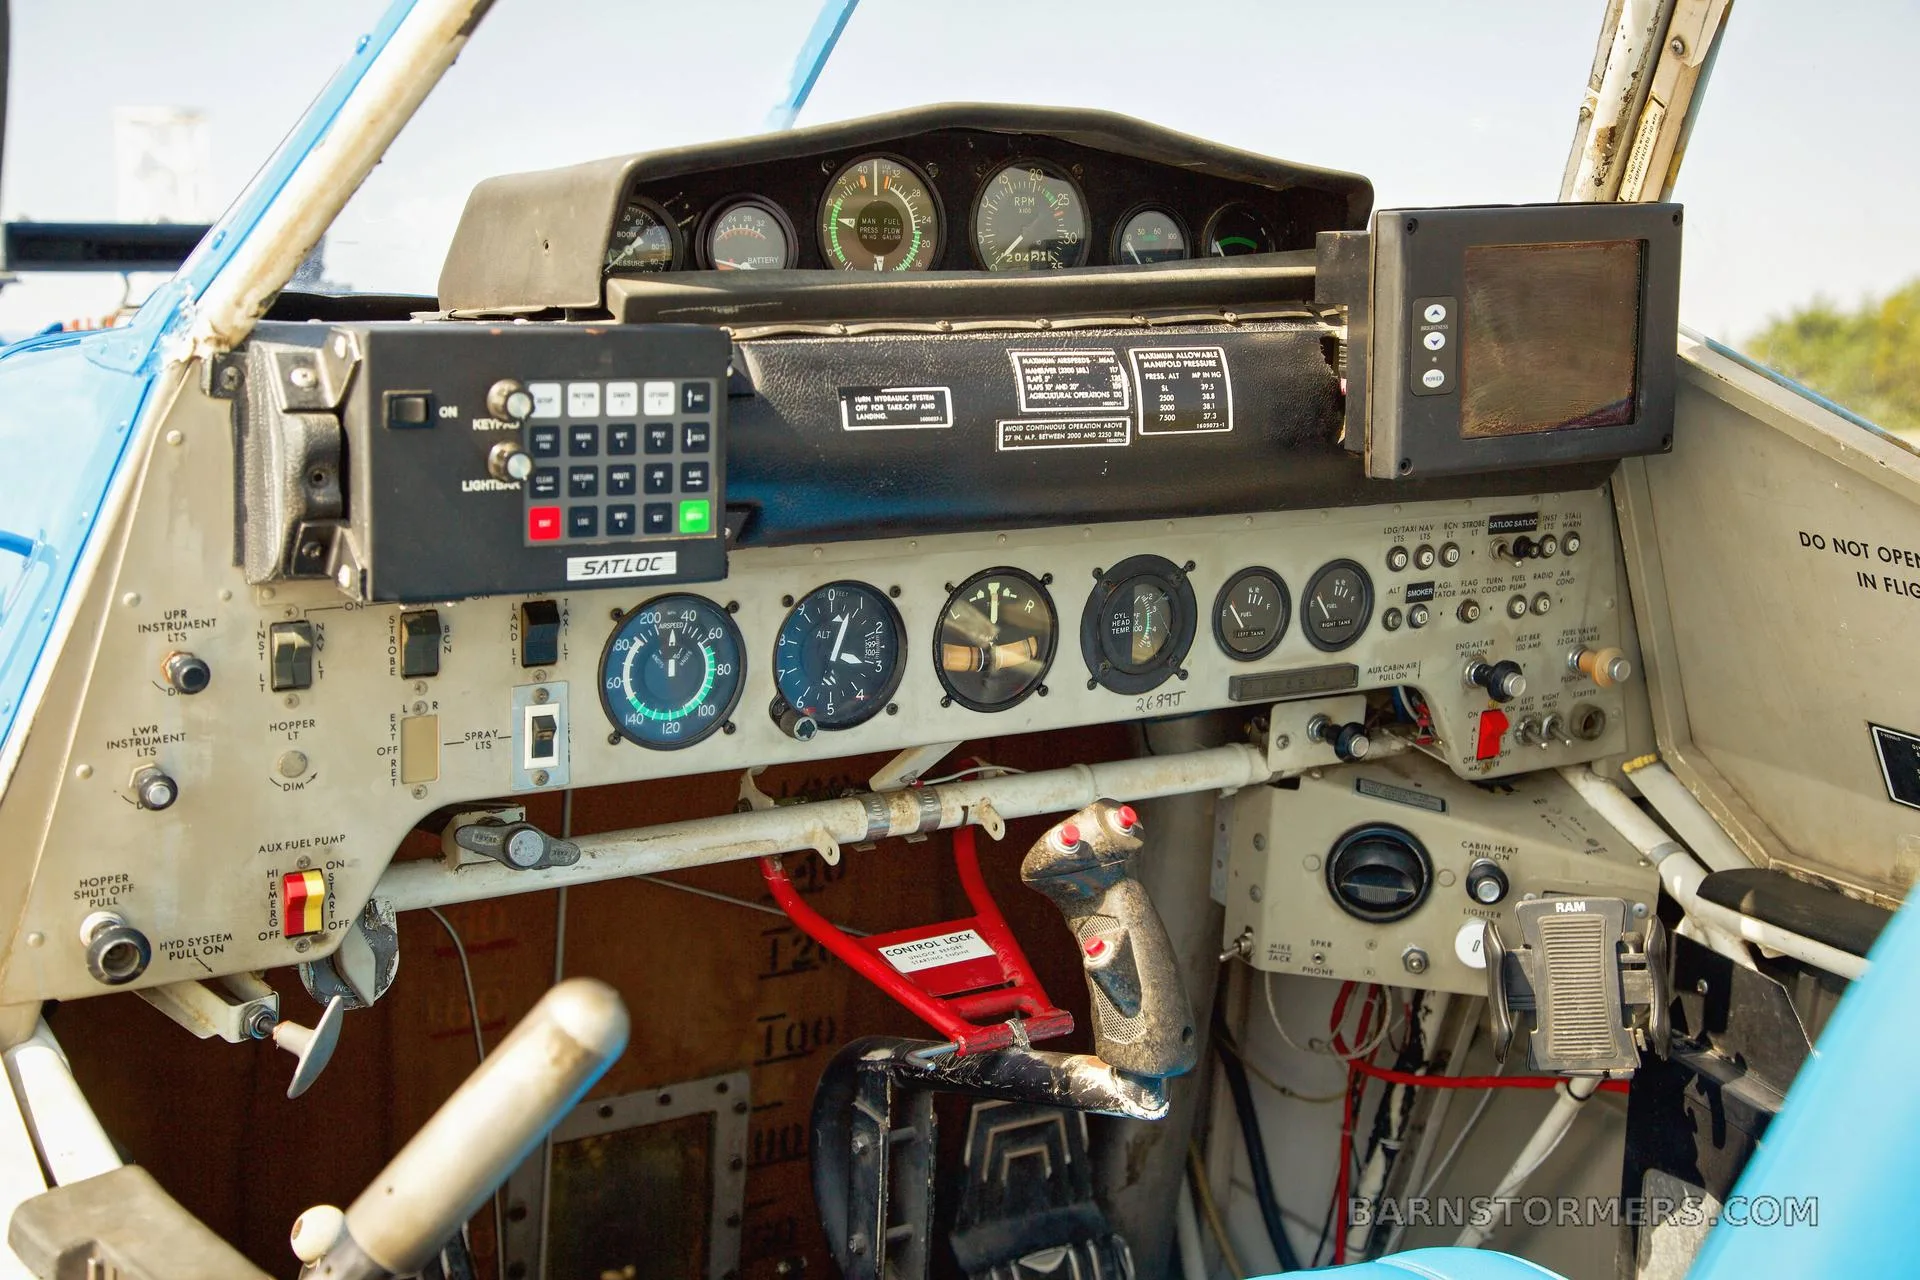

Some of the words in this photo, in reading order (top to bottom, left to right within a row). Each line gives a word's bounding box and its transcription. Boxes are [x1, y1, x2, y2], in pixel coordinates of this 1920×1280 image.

[1015, 197, 1034, 206] RPM
[1058, 194, 1069, 206] 25
[439, 407, 457, 418] ON
[1419, 524, 1434, 532] NAV
[1514, 519, 1537, 527] SATLOC
[1799, 531, 1825, 549] DO
[1833, 537, 1868, 559] NOT
[582, 557, 662, 575] SATLOC
[1461, 579, 1478, 587] FLAG
[1556, 578, 1574, 586] COND
[1857, 572, 1877, 590] IN
[1408, 588, 1433, 597] SMOKER
[1481, 585, 1506, 593] COORD
[165, 610, 187, 619] UPR
[640, 612, 661, 624] 200
[681, 611, 696, 621] 40
[138, 618, 216, 633] INSTRUMENT
[1112, 627, 1130, 635] TEMP.
[168, 632, 186, 642] LTS
[316, 624, 324, 652] NAV
[709, 628, 722, 639] 60
[257, 621, 265, 660] INST
[388, 616, 396, 676] STROBE
[318, 661, 324, 679] LT
[717, 664, 731, 675] 80
[1367, 666, 1382, 675] AUX
[1383, 664, 1406, 673] CABIN
[1407, 662, 1417, 670] AIR
[1379, 672, 1394, 680] PULL
[260, 674, 264, 692] LT
[698, 705, 715, 716] 100
[625, 714, 644, 725] 140
[133, 725, 158, 736] LWR
[270, 719, 315, 732] HOPPER
[662, 722, 680, 734] 120
[288, 732, 299, 741] LT
[465, 729, 498, 741] SPRAY
[107, 733, 186, 749] INSTRUMENT
[475, 741, 492, 749] LTS
[137, 747, 156, 757] LTS
[377, 746, 398, 756] OFF
[283, 782, 304, 791] DIM
[258, 842, 282, 854] AUX
[286, 838, 311, 849] FUEL
[314, 834, 346, 845] PUMP
[1462, 841, 1491, 850] CABIN
[1495, 845, 1519, 854] HEAT
[326, 860, 344, 870] ON
[80, 874, 128, 888] HOPPER
[74, 888, 105, 900] SHUT
[110, 884, 134, 894] OFF
[90, 896, 118, 908] PULL
[1556, 901, 1586, 912] RAM
[1464, 908, 1501, 918] LIGHTER
[329, 920, 350, 929] OFF
[258, 930, 280, 941] OFF
[160, 940, 184, 950] HYD
[188, 933, 232, 948] SYSTEM
[885, 940, 940, 957] CONTROL
[943, 933, 974, 944] LOCK
[169, 949, 198, 960] PULL
[203, 944, 224, 955] ON
[1302, 966, 1334, 976] PHONE
